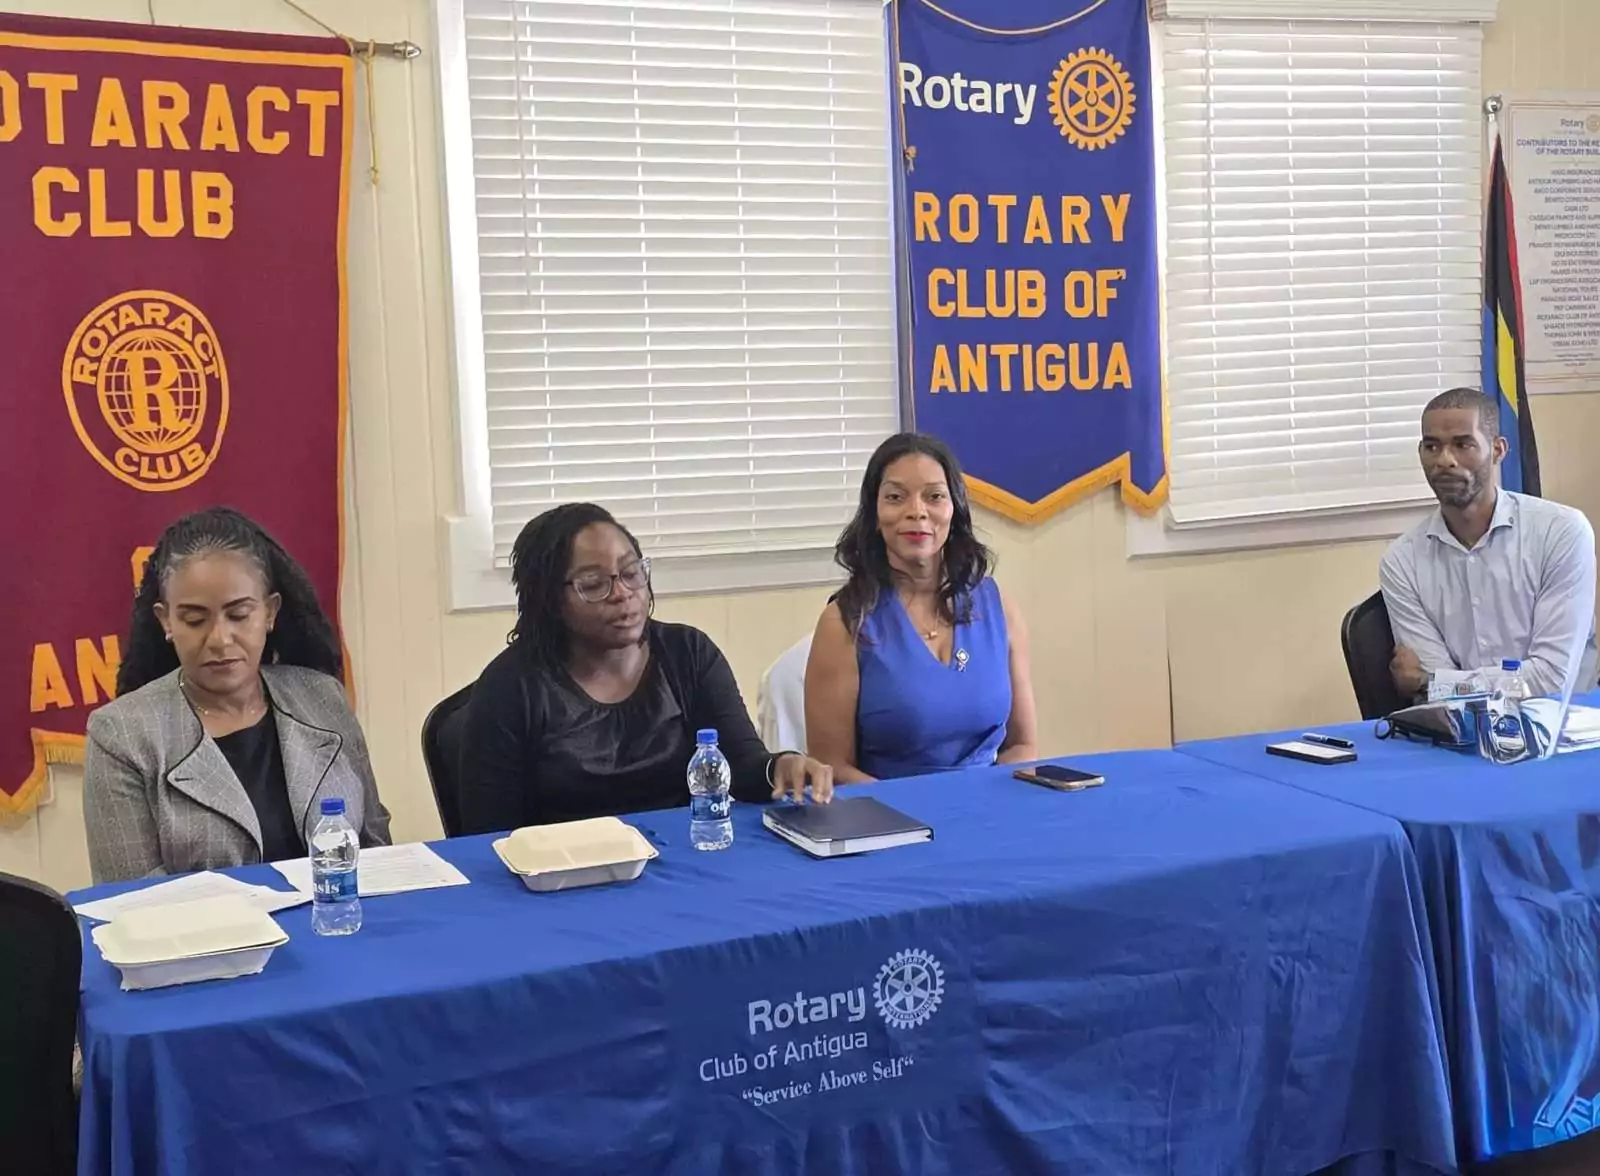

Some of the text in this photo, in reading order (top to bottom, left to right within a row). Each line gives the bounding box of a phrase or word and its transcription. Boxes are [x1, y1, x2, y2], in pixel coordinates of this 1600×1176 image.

[898, 61, 1037, 126] Rotary
[1516, 139, 1567, 147] CONTRIBUTORS
[1568, 139, 1577, 147] TO
[1578, 139, 1591, 147] THE
[1560, 118, 1584, 128] Rotary
[1535, 148, 1546, 156] OF
[1547, 148, 1559, 156] THE
[1560, 147, 1584, 156] ROTARY
[32, 166, 235, 240] CLUB
[913, 191, 1131, 244] ROTARY
[928, 266, 1127, 319] CLUB OF
[72, 302, 220, 386] ROTARACT
[930, 340, 1133, 394] ANTIGUA
[118, 349, 193, 434] R
[114, 446, 207, 481] CLUB
[748, 986, 866, 1036] Rotary
[699, 1030, 869, 1083] Club of Antigua
[818, 1067, 868, 1093] Above
